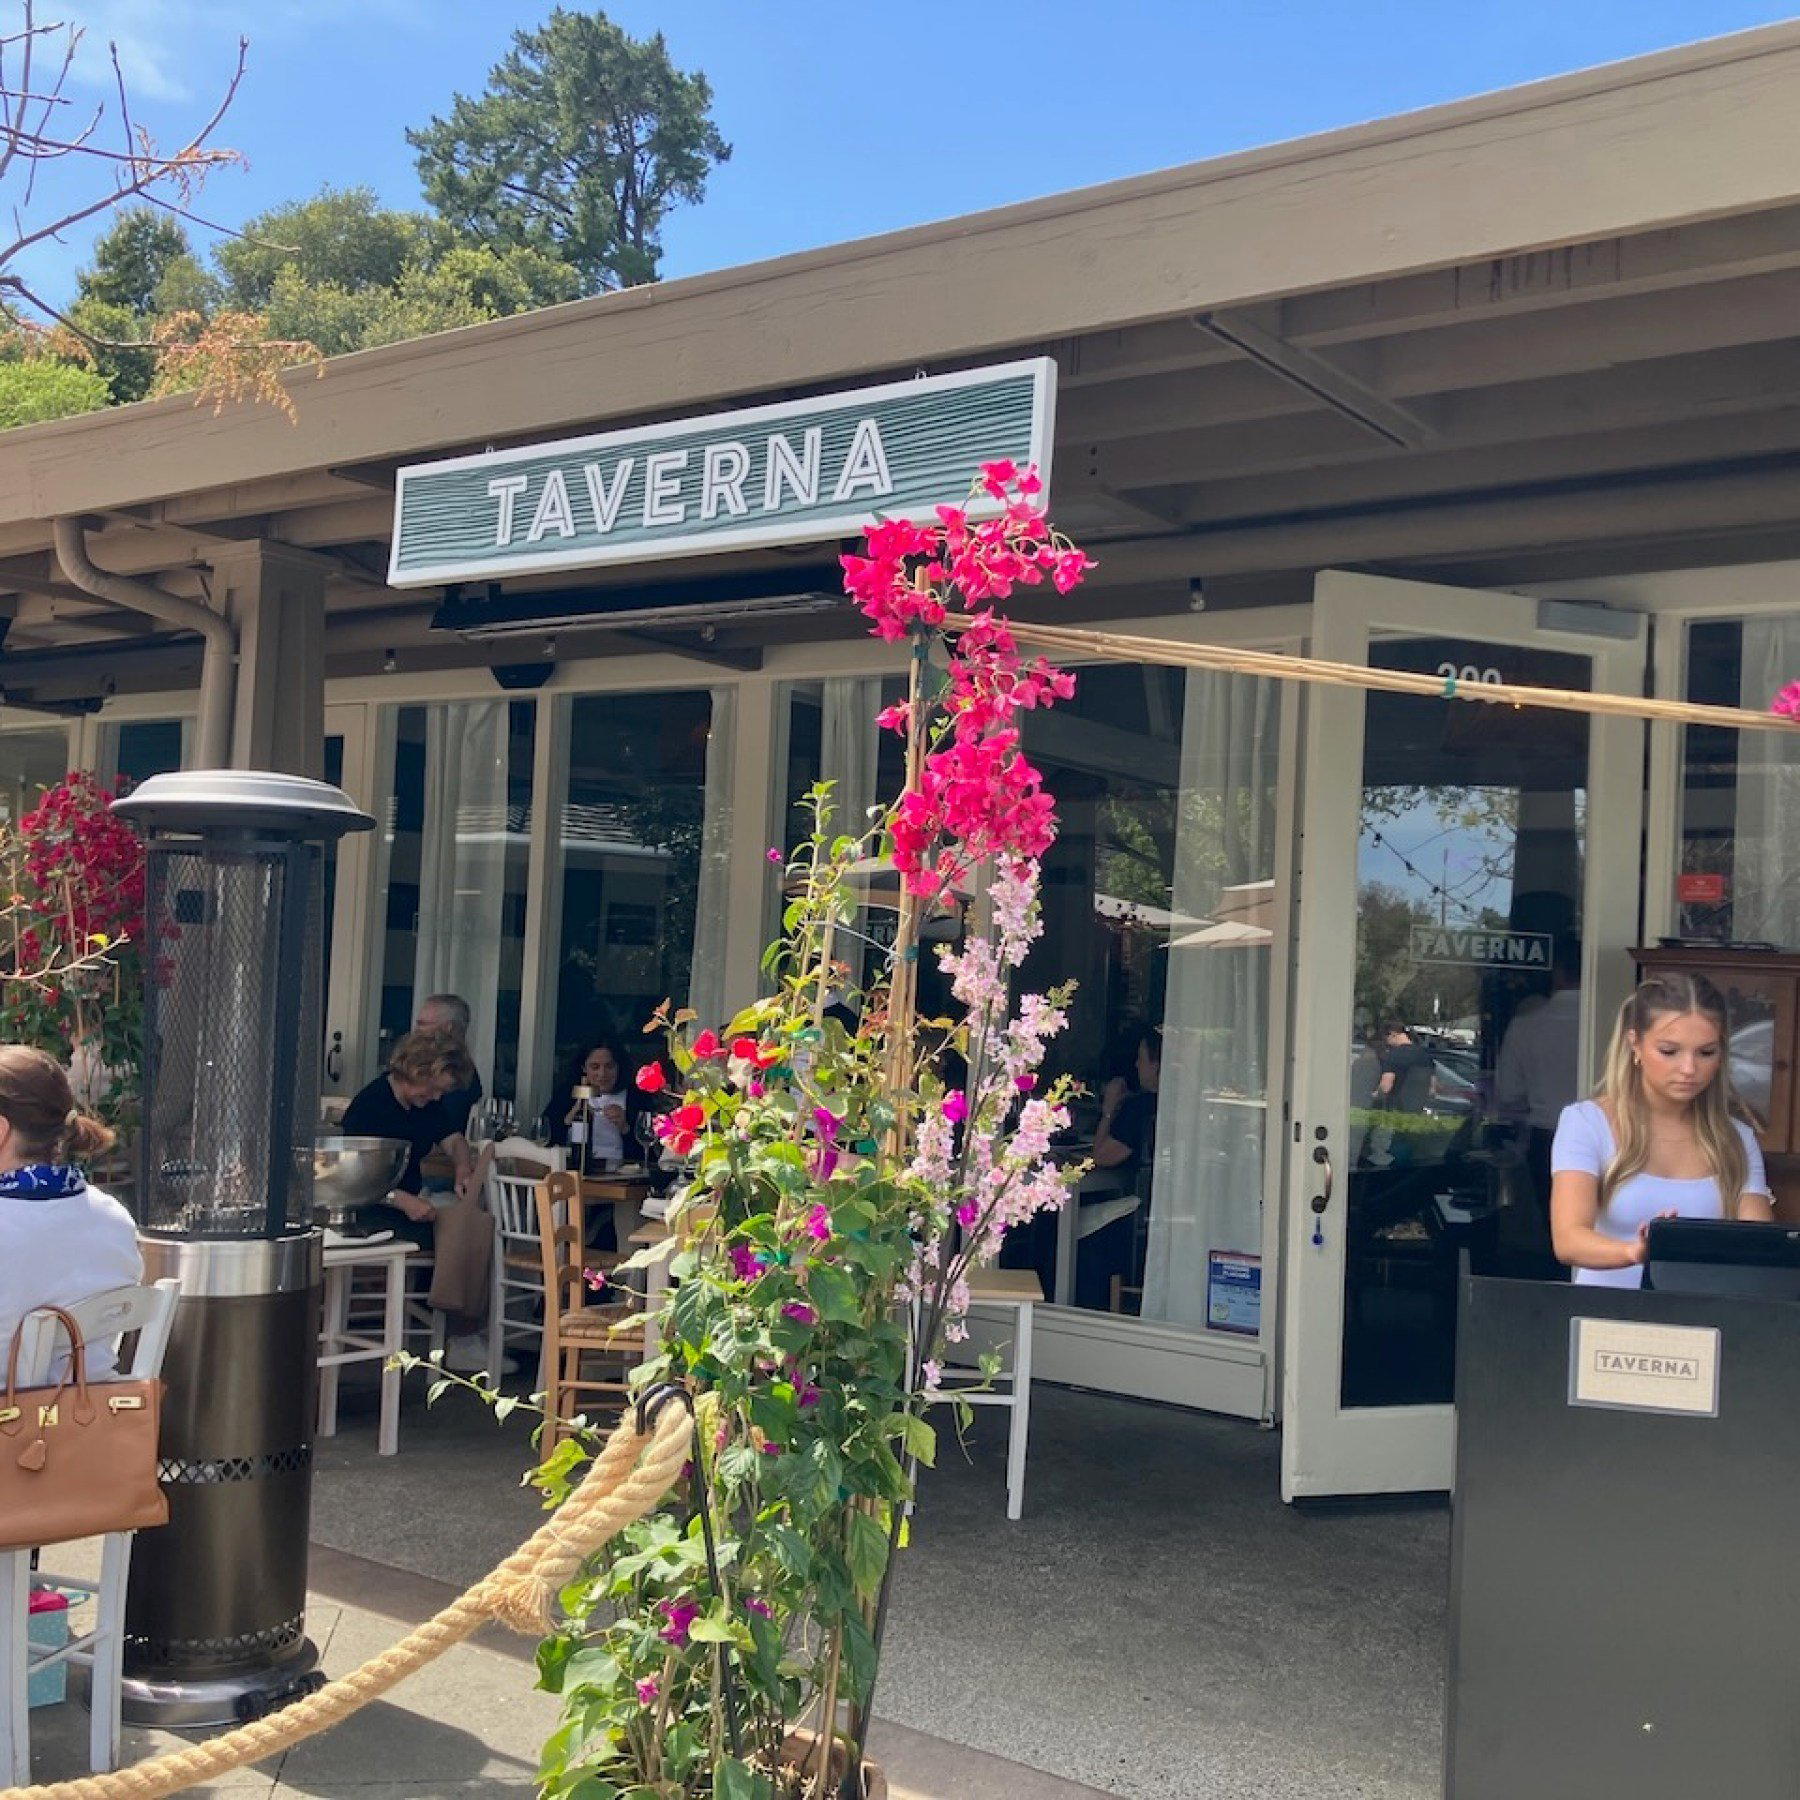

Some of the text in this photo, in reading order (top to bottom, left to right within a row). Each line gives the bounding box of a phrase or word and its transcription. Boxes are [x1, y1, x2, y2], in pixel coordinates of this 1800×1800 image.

[488, 419, 894, 546] TAVERNA
[1416, 931, 1545, 961] TAVERNA
[1600, 1355, 1692, 1375] TAVERNA
